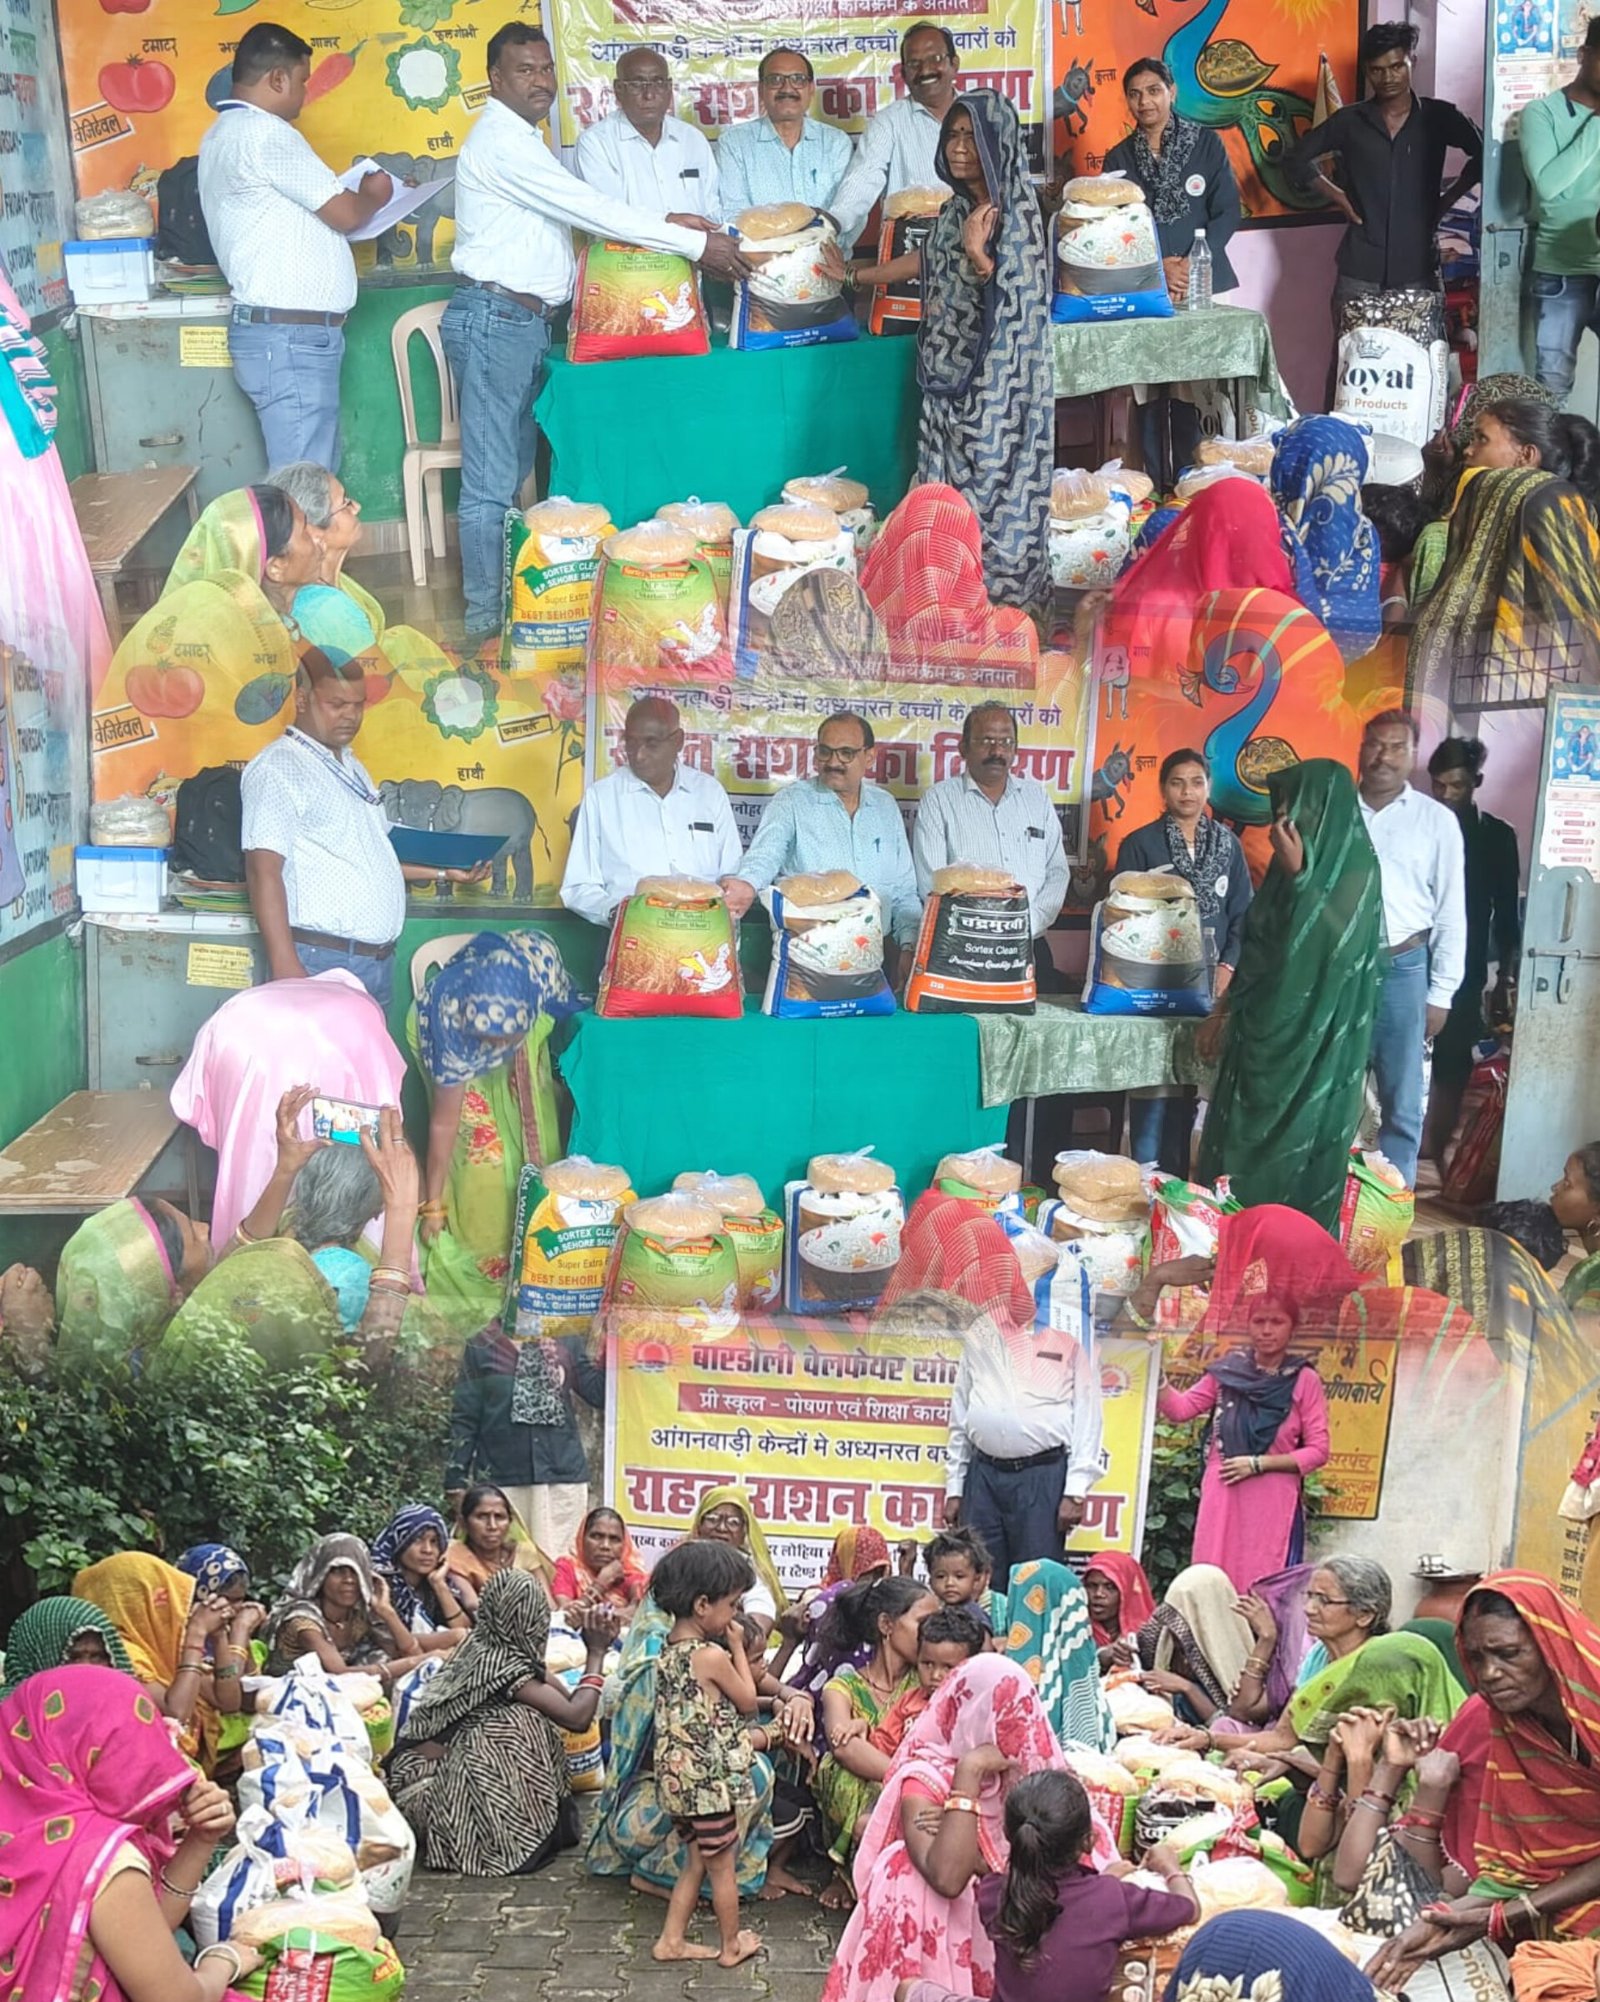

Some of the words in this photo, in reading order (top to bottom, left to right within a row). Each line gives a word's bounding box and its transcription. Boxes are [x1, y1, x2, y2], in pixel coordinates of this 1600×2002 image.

[994, 26, 1017, 49] को
[1355, 398, 1409, 411] Products
[541, 563, 576, 580] SORTEX
[521, 609, 543, 620] BEST
[901, 698, 943, 722] बच्चों
[1039, 706, 1062, 727] को
[964, 942, 994, 955] Sortex
[995, 945, 1019, 956] Clean
[556, 1228, 592, 1243] SORTEX
[562, 1239, 596, 1252] SEHORE
[557, 1259, 581, 1270] Super
[583, 1258, 604, 1268] Extra
[530, 1272, 555, 1285] BEST
[558, 1274, 598, 1286] SEHORI
[700, 1388, 718, 1409] प्री
[722, 1393, 765, 1416] स्कूल
[785, 1391, 833, 1416] पोषण
[837, 1398, 862, 1419] एवं
[865, 1398, 908, 1421] शिक्षा
[758, 1428, 808, 1456] केन्द्रों
[835, 1440, 921, 1463] अध्यनरत
[746, 1476, 872, 1526] राशन
[881, 1482, 947, 1531] का
